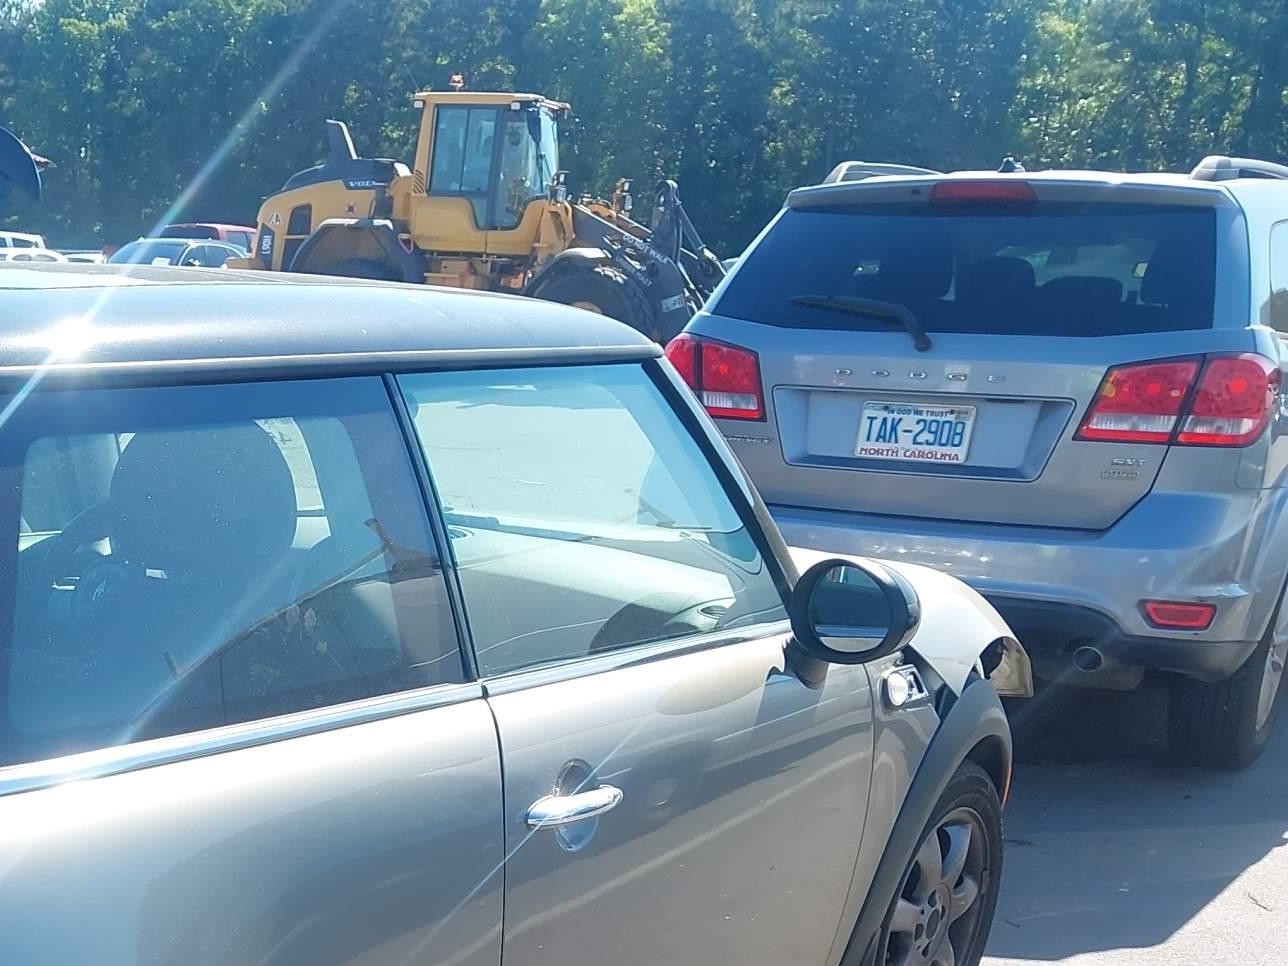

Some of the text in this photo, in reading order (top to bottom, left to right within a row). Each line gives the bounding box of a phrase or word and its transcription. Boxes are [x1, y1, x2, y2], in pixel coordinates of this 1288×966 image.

[835, 368, 1006, 383] DODGE
[913, 409, 923, 417] WE
[926, 410, 949, 418] TRUST
[865, 416, 966, 448] TAK-2908
[859, 447, 960, 461] NORTH CAROLINA
